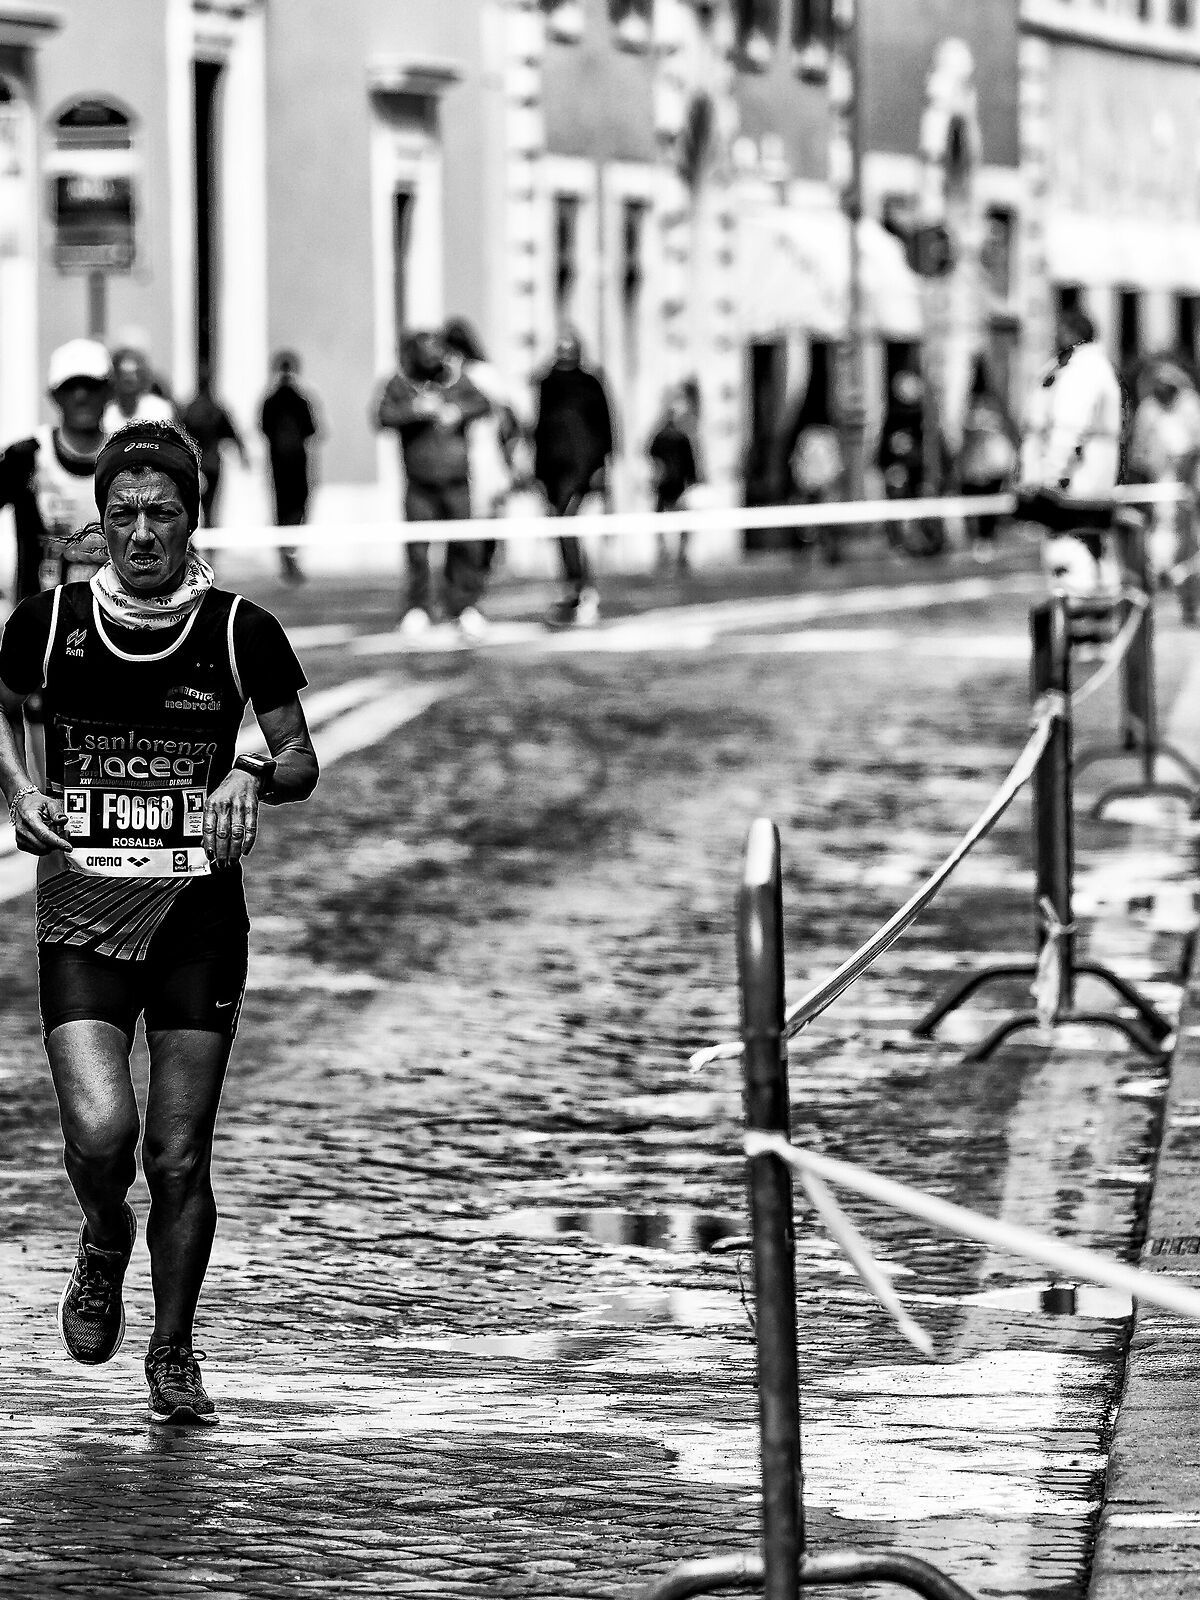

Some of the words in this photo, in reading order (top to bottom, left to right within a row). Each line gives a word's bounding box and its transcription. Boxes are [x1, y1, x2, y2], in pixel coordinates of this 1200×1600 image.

[135, 442, 160, 450] asics
[103, 756, 194, 779] acea
[79, 777, 93, 785] XXV
[102, 793, 174, 830] F9668
[112, 837, 164, 847] ROSALBA
[86, 855, 122, 867] arena
